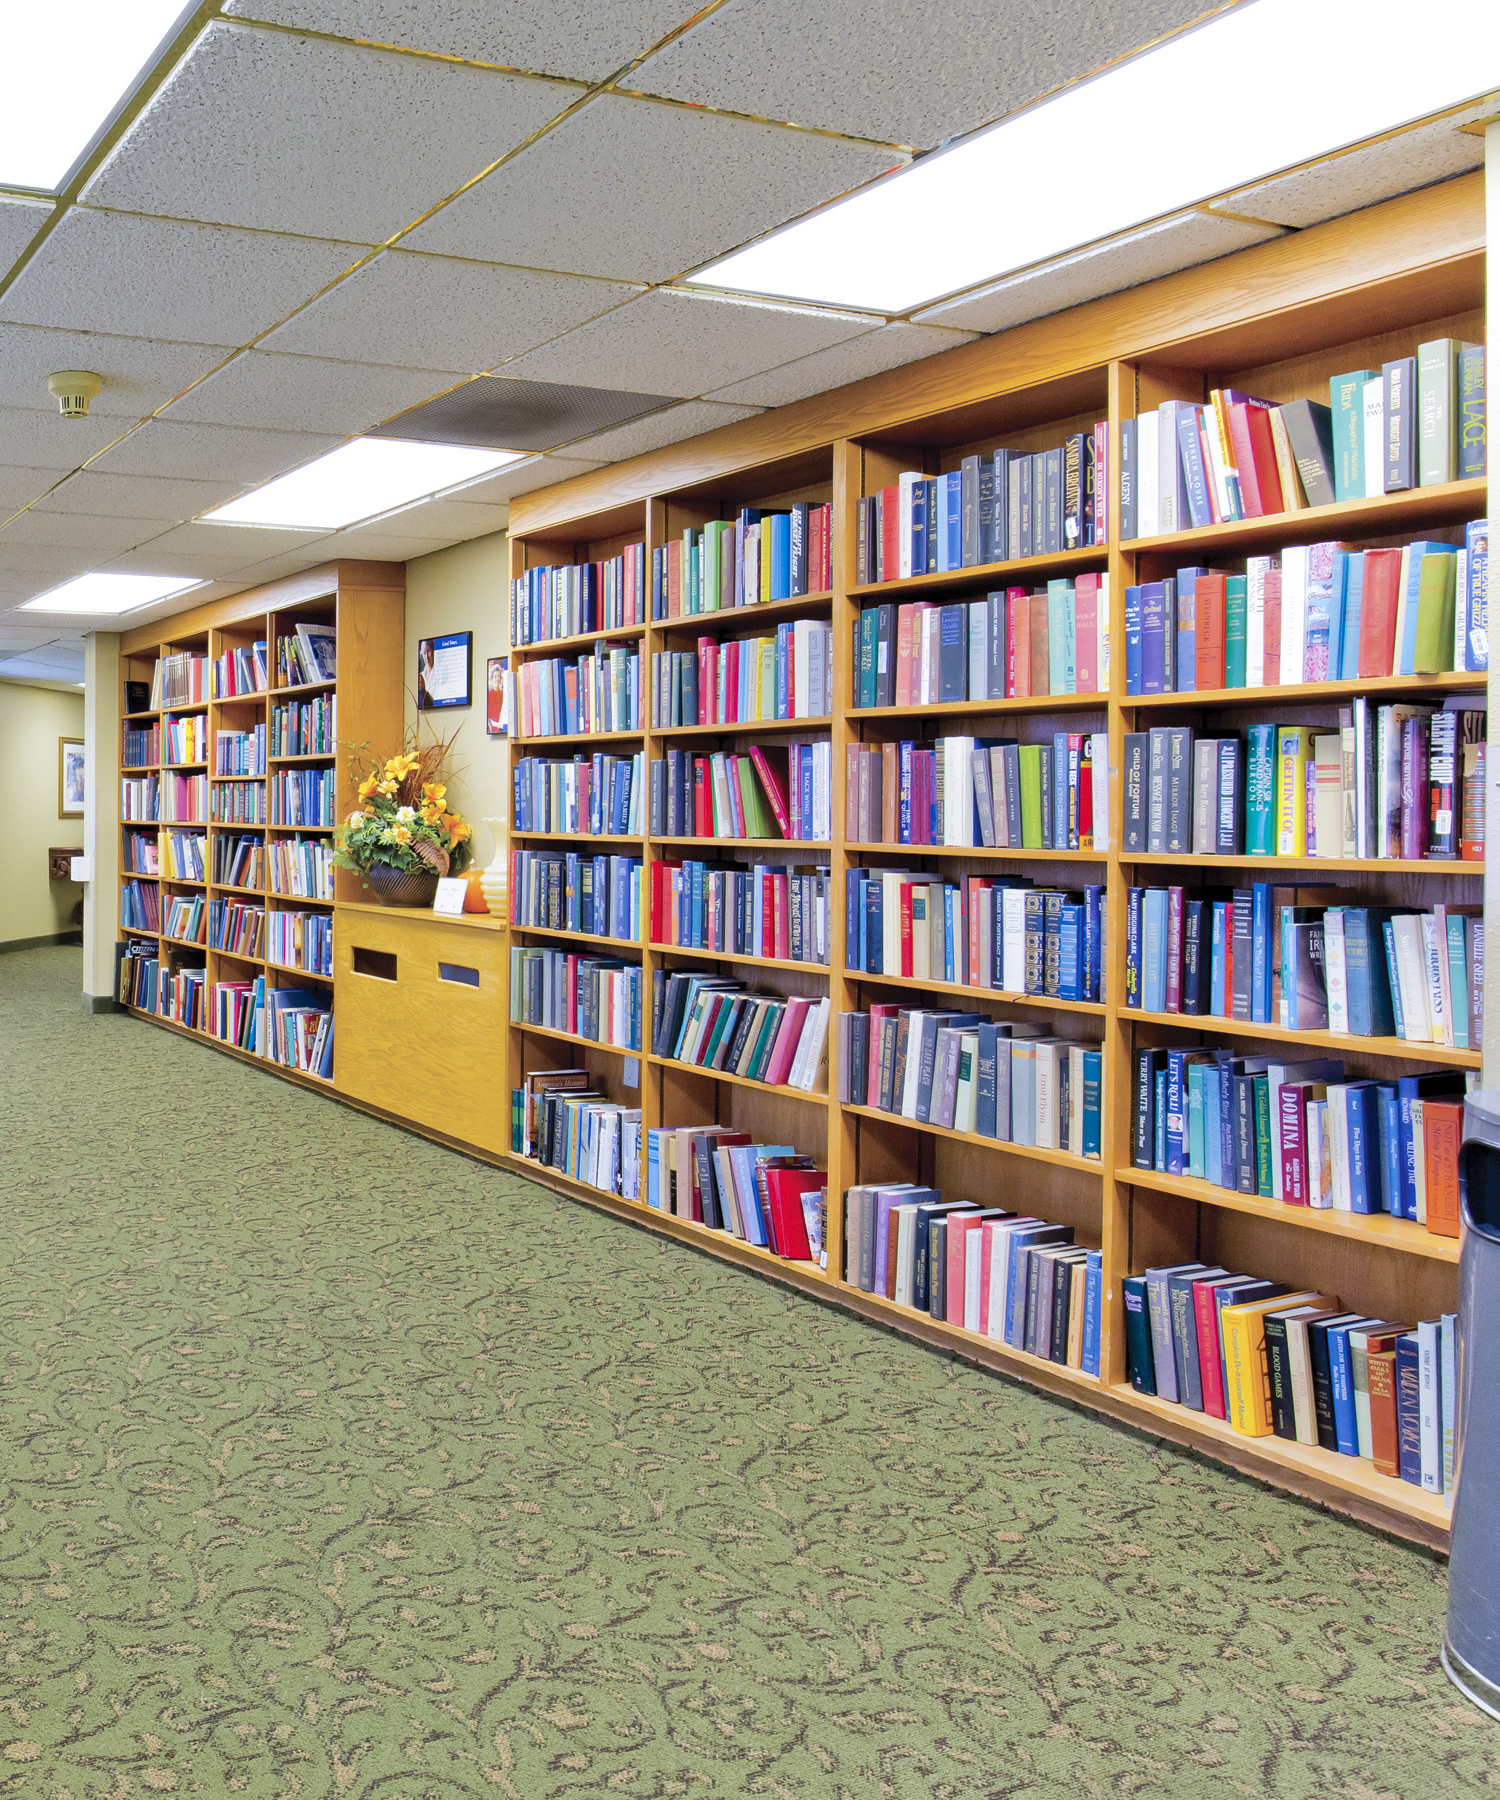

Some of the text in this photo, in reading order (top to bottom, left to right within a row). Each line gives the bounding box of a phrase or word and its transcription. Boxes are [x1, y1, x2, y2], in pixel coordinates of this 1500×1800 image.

[1464, 356, 1475, 396] CONRAN
[1474, 357, 1485, 389] SHIRLEY
[1340, 382, 1357, 411] FRIDA
[1424, 389, 1436, 438] SEARCH
[1463, 399, 1486, 449] LACE
[1065, 437, 1081, 507] SANDRA BROWN
[1097, 462, 1104, 470] IN
[1390, 443, 1401, 462] BAYOU
[1121, 471, 1131, 506] ALGENY
[1473, 576, 1481, 597] TRUE
[1203, 597, 1212, 643] STEINBECK
[1430, 713, 1455, 754] SILENT
[1068, 751, 1077, 786] GLENN BECK
[1249, 757, 1257, 801] BURTON
[1256, 747, 1264, 812] RICHARD FRANCIS
[1264, 757, 1272, 802] CAPTAIN SIR
[1403, 734, 1412, 786] PURPOSE DRIVEN
[1430, 756, 1454, 784] COUP
[621, 765, 632, 824] THE ROYAL FAMILY
[1132, 748, 1141, 820] CHILD OF FORTUNE
[1152, 776, 1163, 832] MESSAGE FROM NAM
[1171, 777, 1180, 833] MIRROR IMAGE
[1130, 893, 1138, 954] MARY HIGGINS CLARK
[1473, 924, 1484, 986] DANIELLE STEEL
[894, 1066, 903, 1096] Chance
[922, 1037, 933, 1086] NO SAFE PLACE
[1139, 1056, 1148, 1112] TERRY WAITE
[1039, 1073, 1048, 1124] Errol Flynn
[1168, 1058, 1179, 1111] LET'S ROLL!
[1221, 1071, 1229, 1099] Mother's
[1220, 1100, 1230, 1119] Story
[1282, 1092, 1299, 1150] DOMINA
[1401, 1097, 1409, 1124] HOWARD
[1353, 1140, 1361, 1154] Days
[1354, 1160, 1362, 1175] Paris
[1432, 1121, 1442, 1187] Morton Thompson
[1444, 1123, 1455, 1217] NOT STRANGER
[931, 1238, 939, 1259] Family
[931, 1280, 939, 1296] Puzo
[1087, 1291, 1095, 1312] Future
[1148, 1280, 1159, 1302] The
[1085, 1322, 1094, 1348] Success
[1199, 1290, 1207, 1305] THE
[1203, 1326, 1212, 1358] WITHIN
[1231, 1328, 1241, 1359] Complete
[1238, 1404, 1246, 1429] Manual
[1272, 1345, 1283, 1399] BLOOD GAMES
